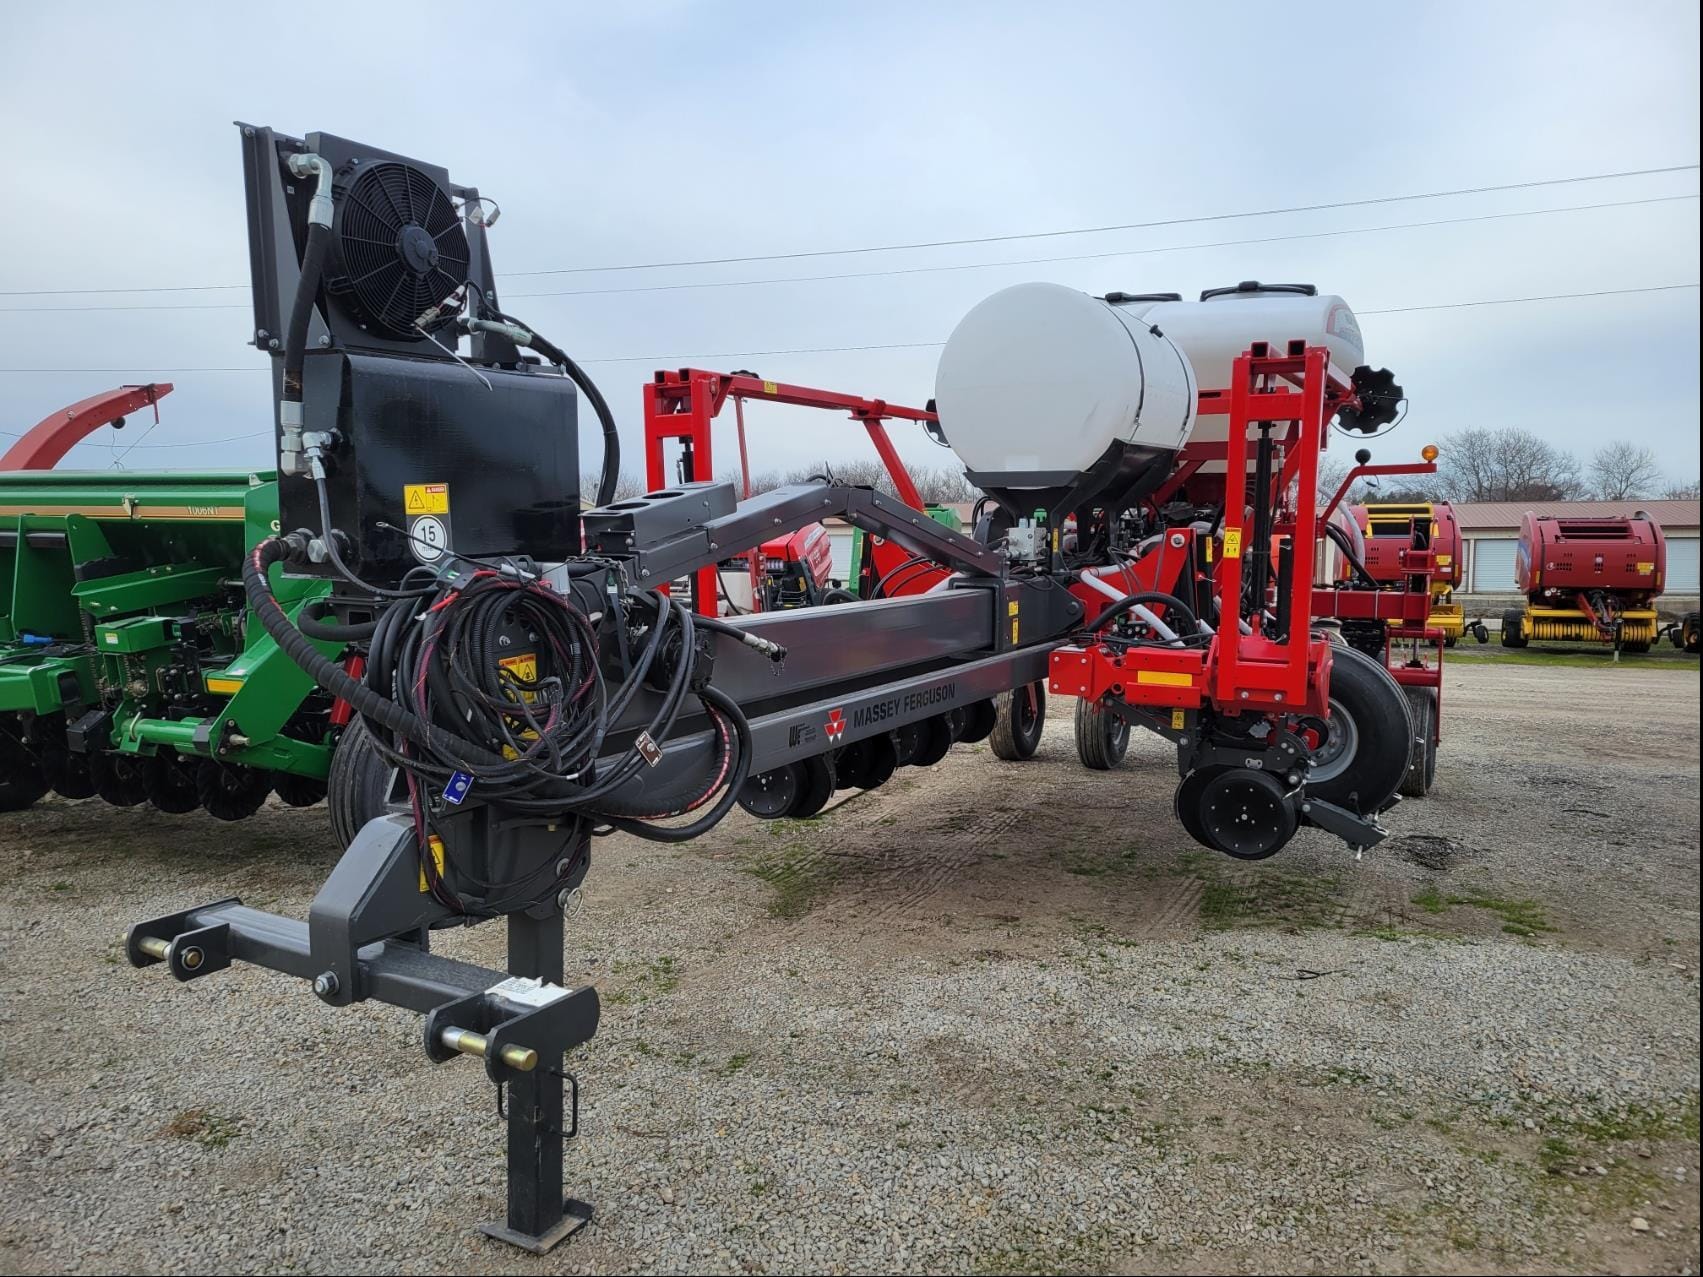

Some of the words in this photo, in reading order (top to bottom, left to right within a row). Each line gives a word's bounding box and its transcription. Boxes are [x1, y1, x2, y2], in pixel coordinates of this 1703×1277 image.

[421, 525, 436, 543] 15
[853, 700, 900, 728] MASSEY
[904, 683, 955, 713] FERGUSON
